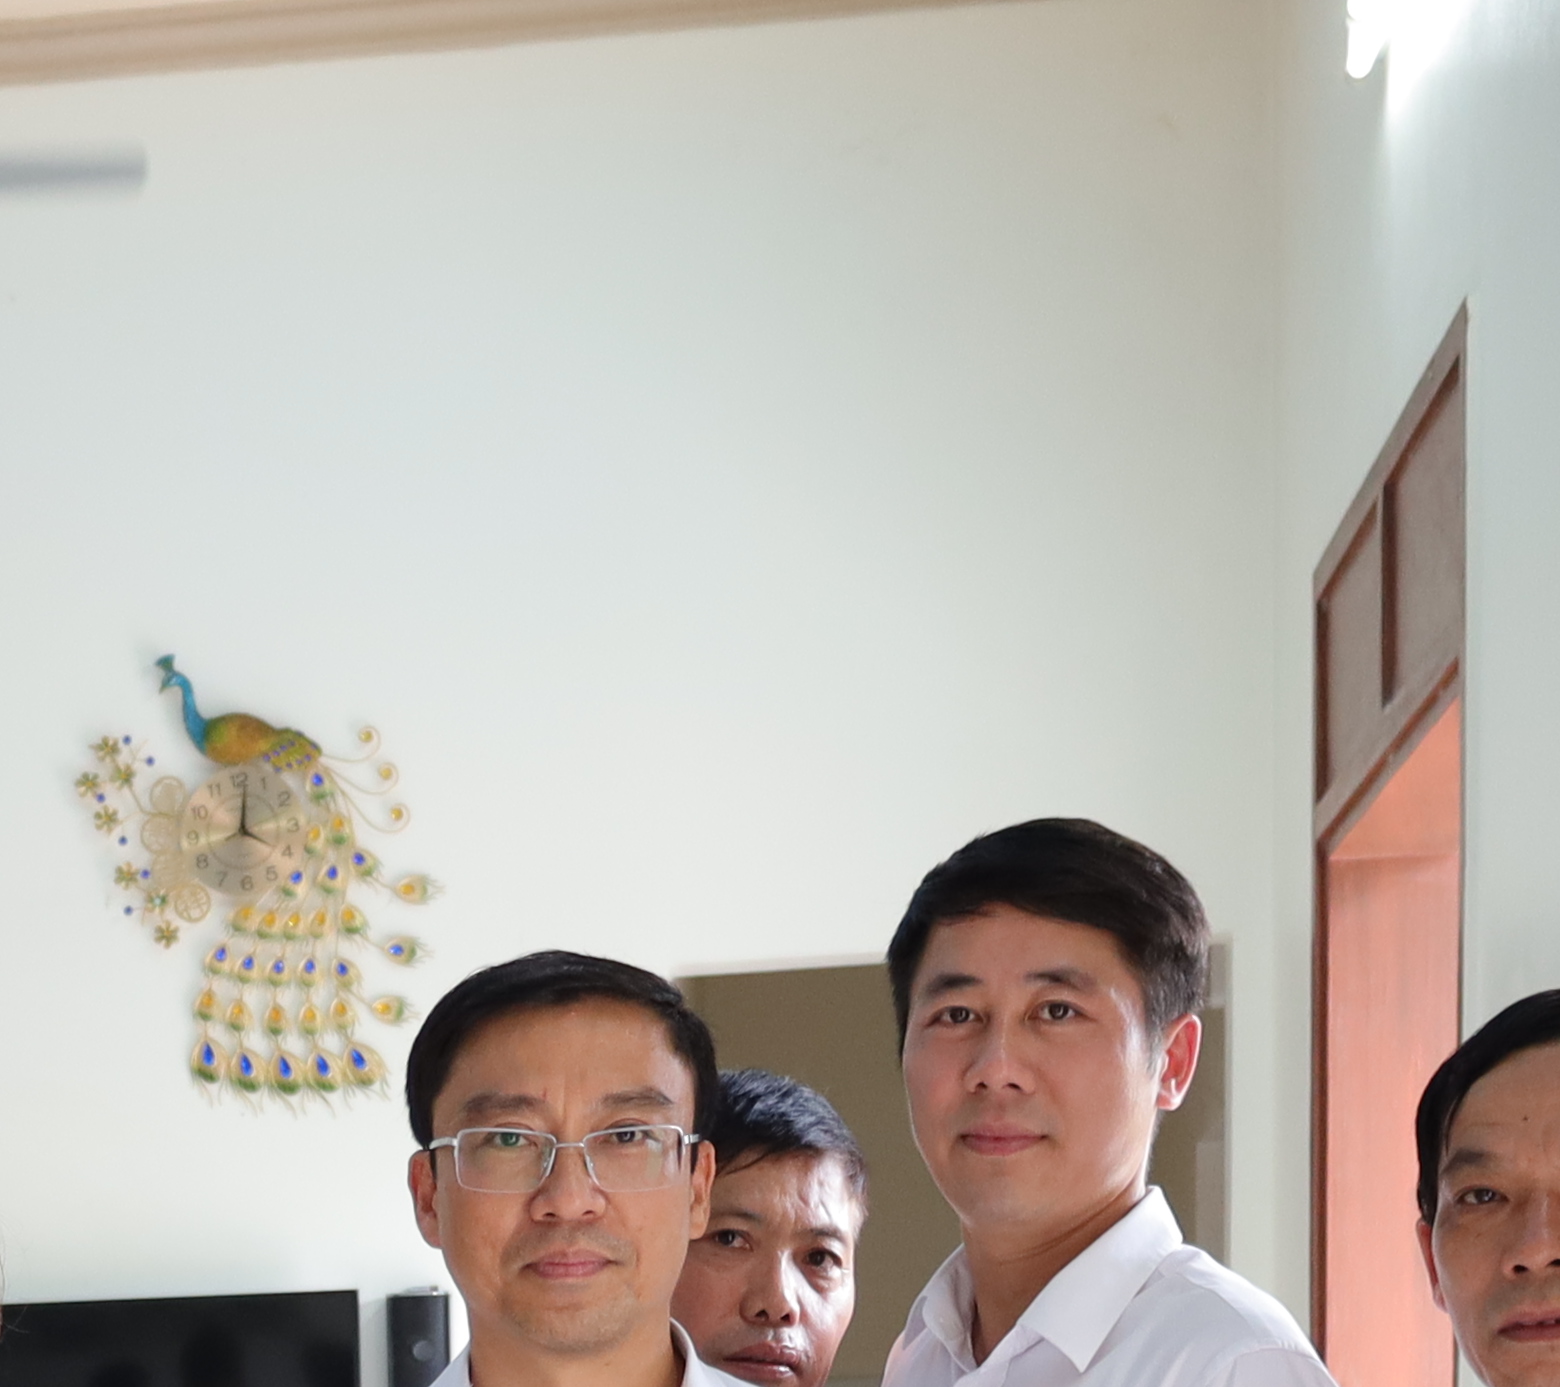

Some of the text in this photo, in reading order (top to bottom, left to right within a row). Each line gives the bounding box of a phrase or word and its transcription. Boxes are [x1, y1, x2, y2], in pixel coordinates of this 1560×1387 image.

[230, 772, 248, 787] 12
[208, 783, 221, 797] 11
[278, 790, 291, 808] 2
[191, 805, 208, 820] 10
[287, 817, 299, 833] 3
[187, 829, 199, 845] 9
[281, 844, 293, 858] 4
[196, 854, 208, 869] 8
[216, 871, 227, 887] 7
[266, 865, 278, 881] 5
[241, 875, 253, 891] 6
